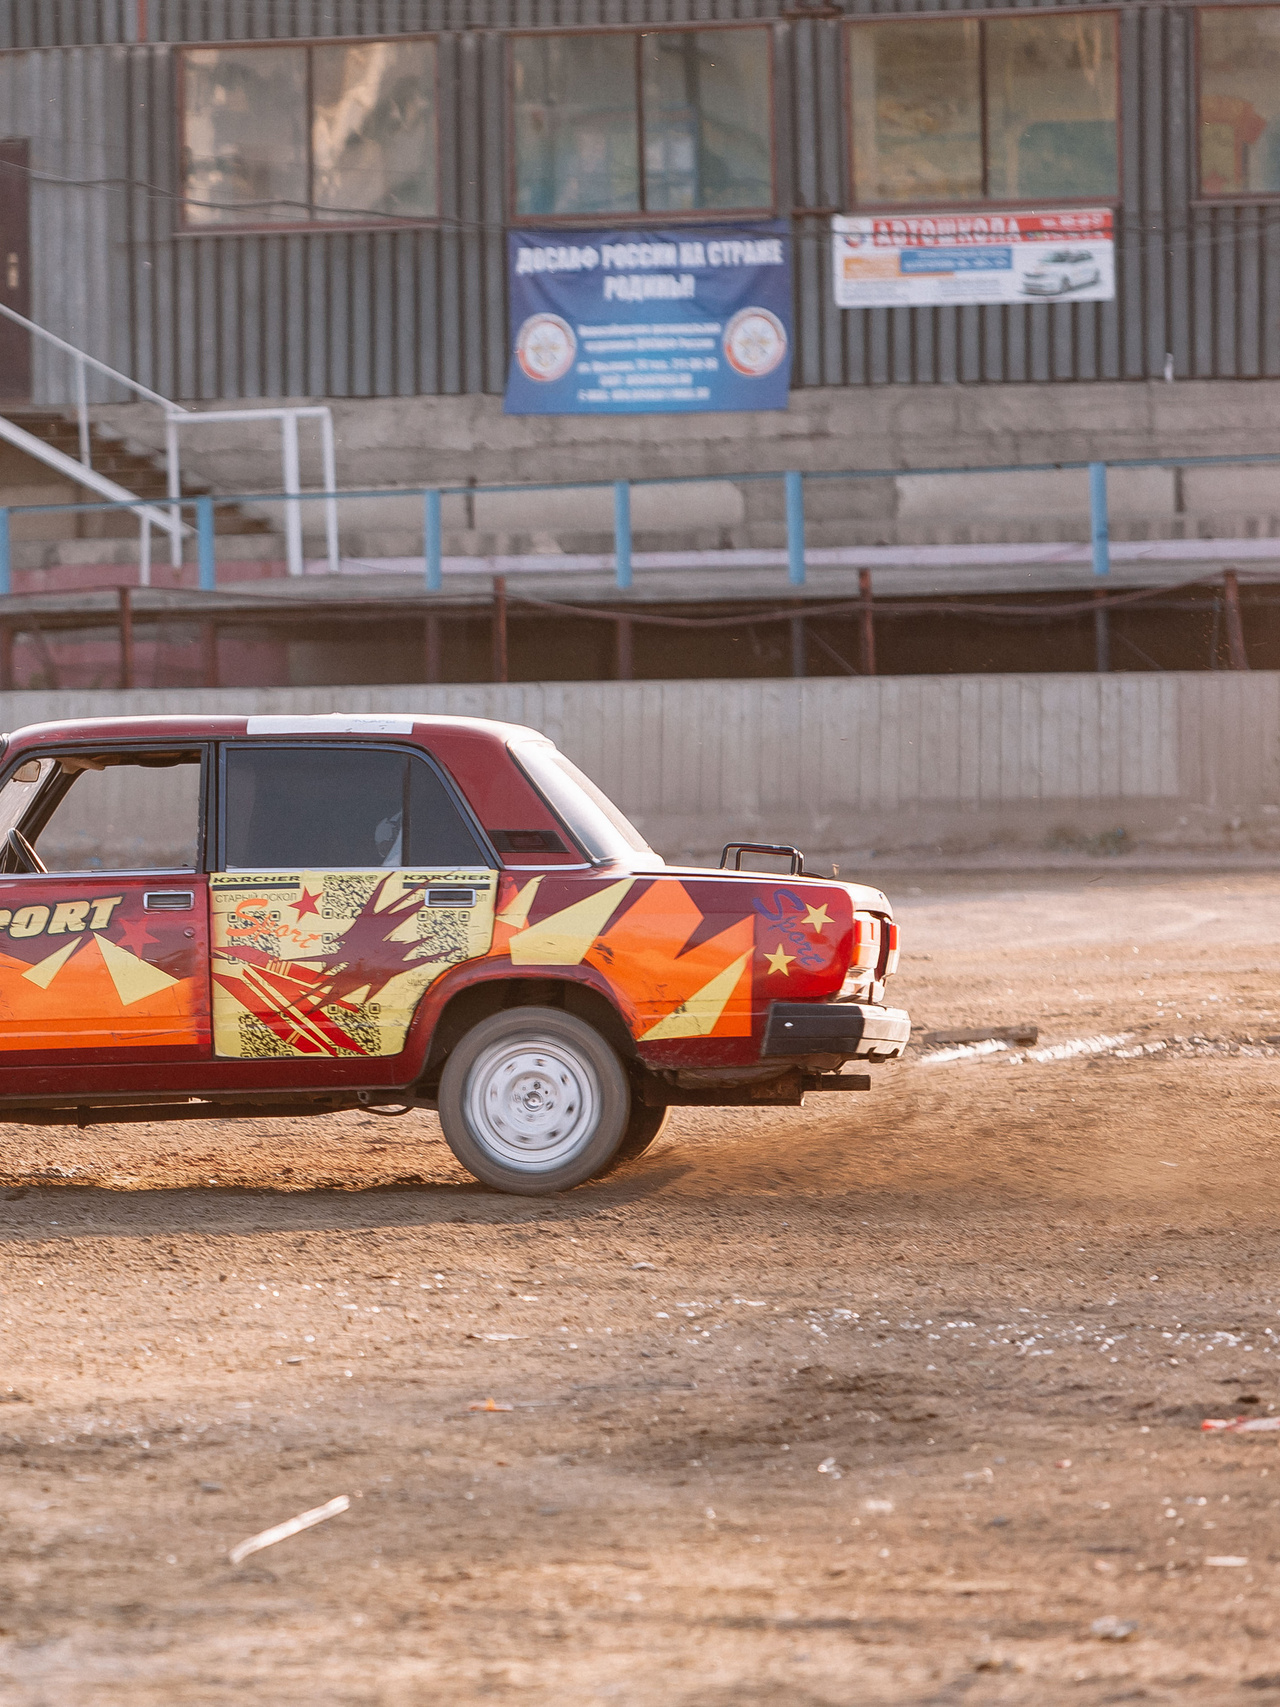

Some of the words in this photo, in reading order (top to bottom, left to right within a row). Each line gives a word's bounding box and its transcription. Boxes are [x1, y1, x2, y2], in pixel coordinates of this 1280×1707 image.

[873, 214, 1020, 247] АВТОШКОЛА
[516, 245, 599, 274] ДОСААФ
[601, 242, 677, 271] РОССИИ
[678, 241, 707, 268] НА
[226, 898, 322, 948] Sport
[752, 888, 825, 966] Sport
